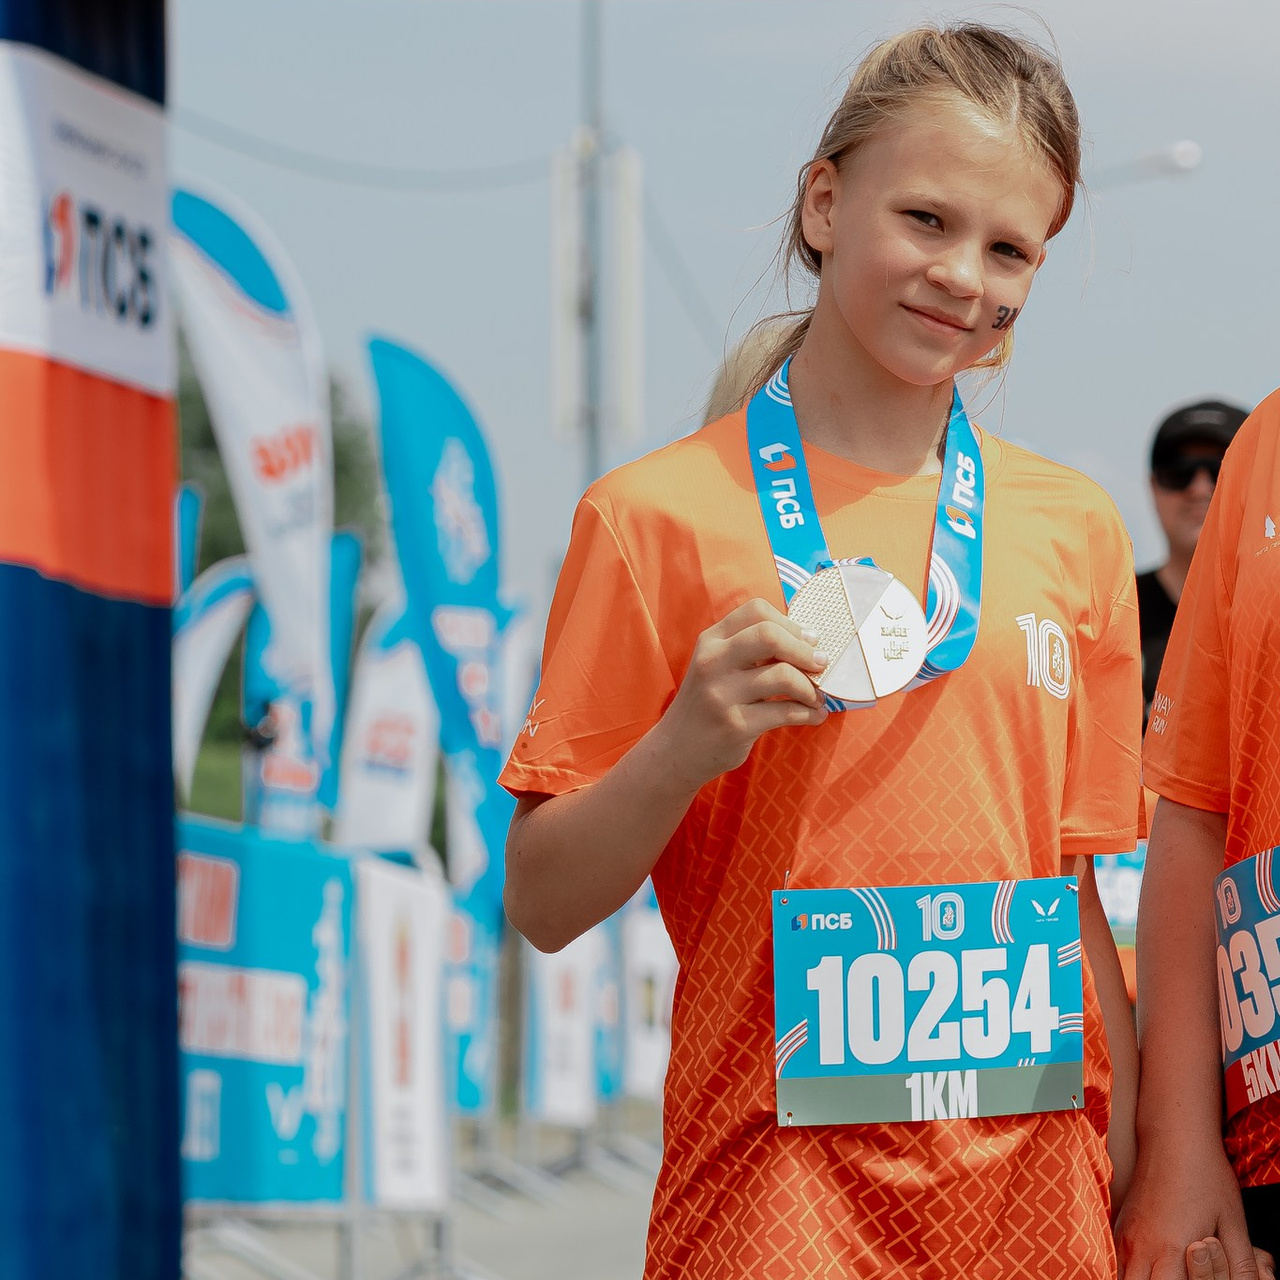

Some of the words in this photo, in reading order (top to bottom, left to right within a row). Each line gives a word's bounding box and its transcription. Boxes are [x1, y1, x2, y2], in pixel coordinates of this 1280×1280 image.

[771, 478, 805, 529] ПСБ
[952, 451, 977, 509] ПСБ
[1015, 612, 1071, 700] 10
[811, 912, 853, 931] ПСБ
[916, 892, 965, 942] 10
[806, 943, 1060, 1066] 10254
